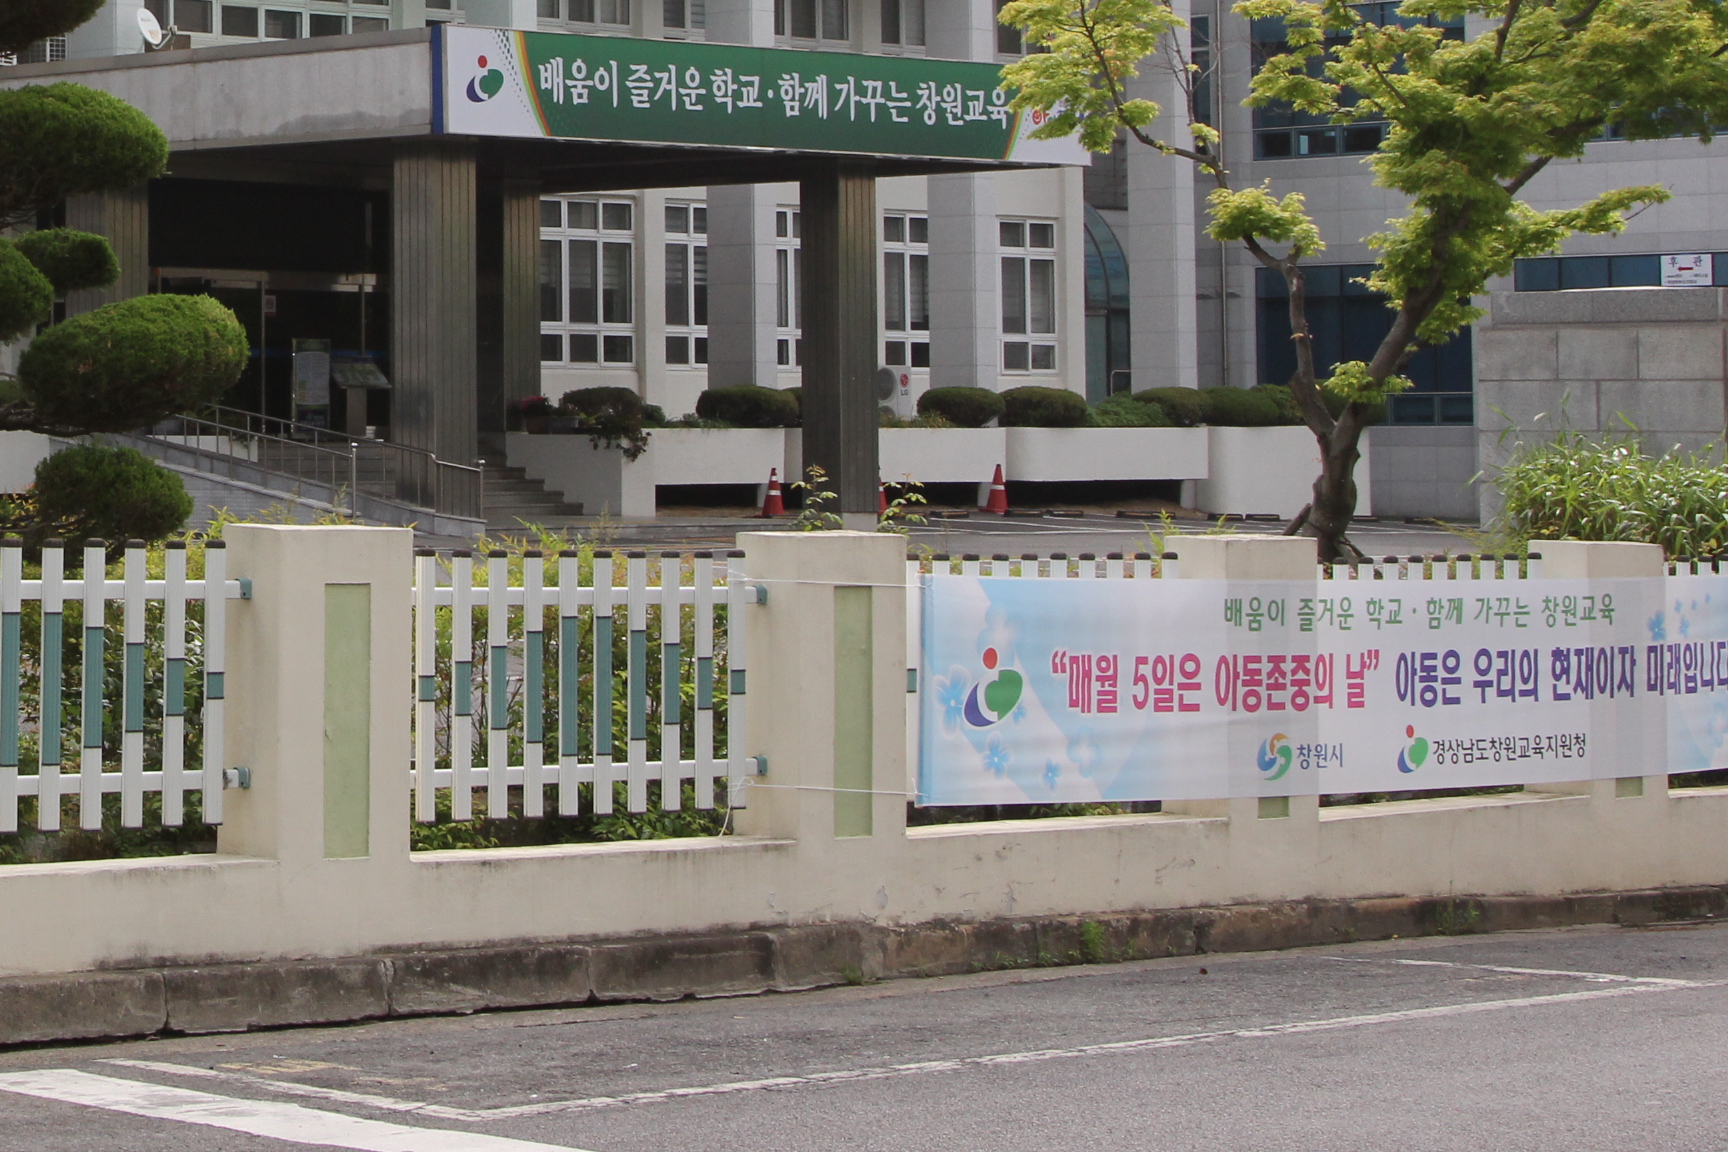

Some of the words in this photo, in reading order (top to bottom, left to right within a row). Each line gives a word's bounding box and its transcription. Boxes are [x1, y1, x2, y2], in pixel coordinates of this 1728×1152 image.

[538, 57, 618, 108] 배움이
[625, 63, 707, 112] 즐거운
[834, 75, 912, 123] 가꾸는
[915, 81, 1010, 130] 창원교육
[1223, 596, 1286, 632] 배움이
[1296, 596, 1354, 632] 즐거운
[1365, 597, 1403, 630] 학교
[1426, 597, 1463, 630] 함께
[1473, 597, 1531, 628] 가꾸는
[1541, 593, 1615, 628] 창원교육
[1132, 652, 1203, 713] 5일은
[1215, 652, 1334, 713] 아동존중의
[1395, 648, 1462, 708] 아동은
[1473, 647, 1539, 705] 우리의
[1550, 644, 1636, 702] 현재이자
[1296, 743, 1344, 770] 창원시
[1432, 732, 1586, 765] 경상남도창원교육지원청
